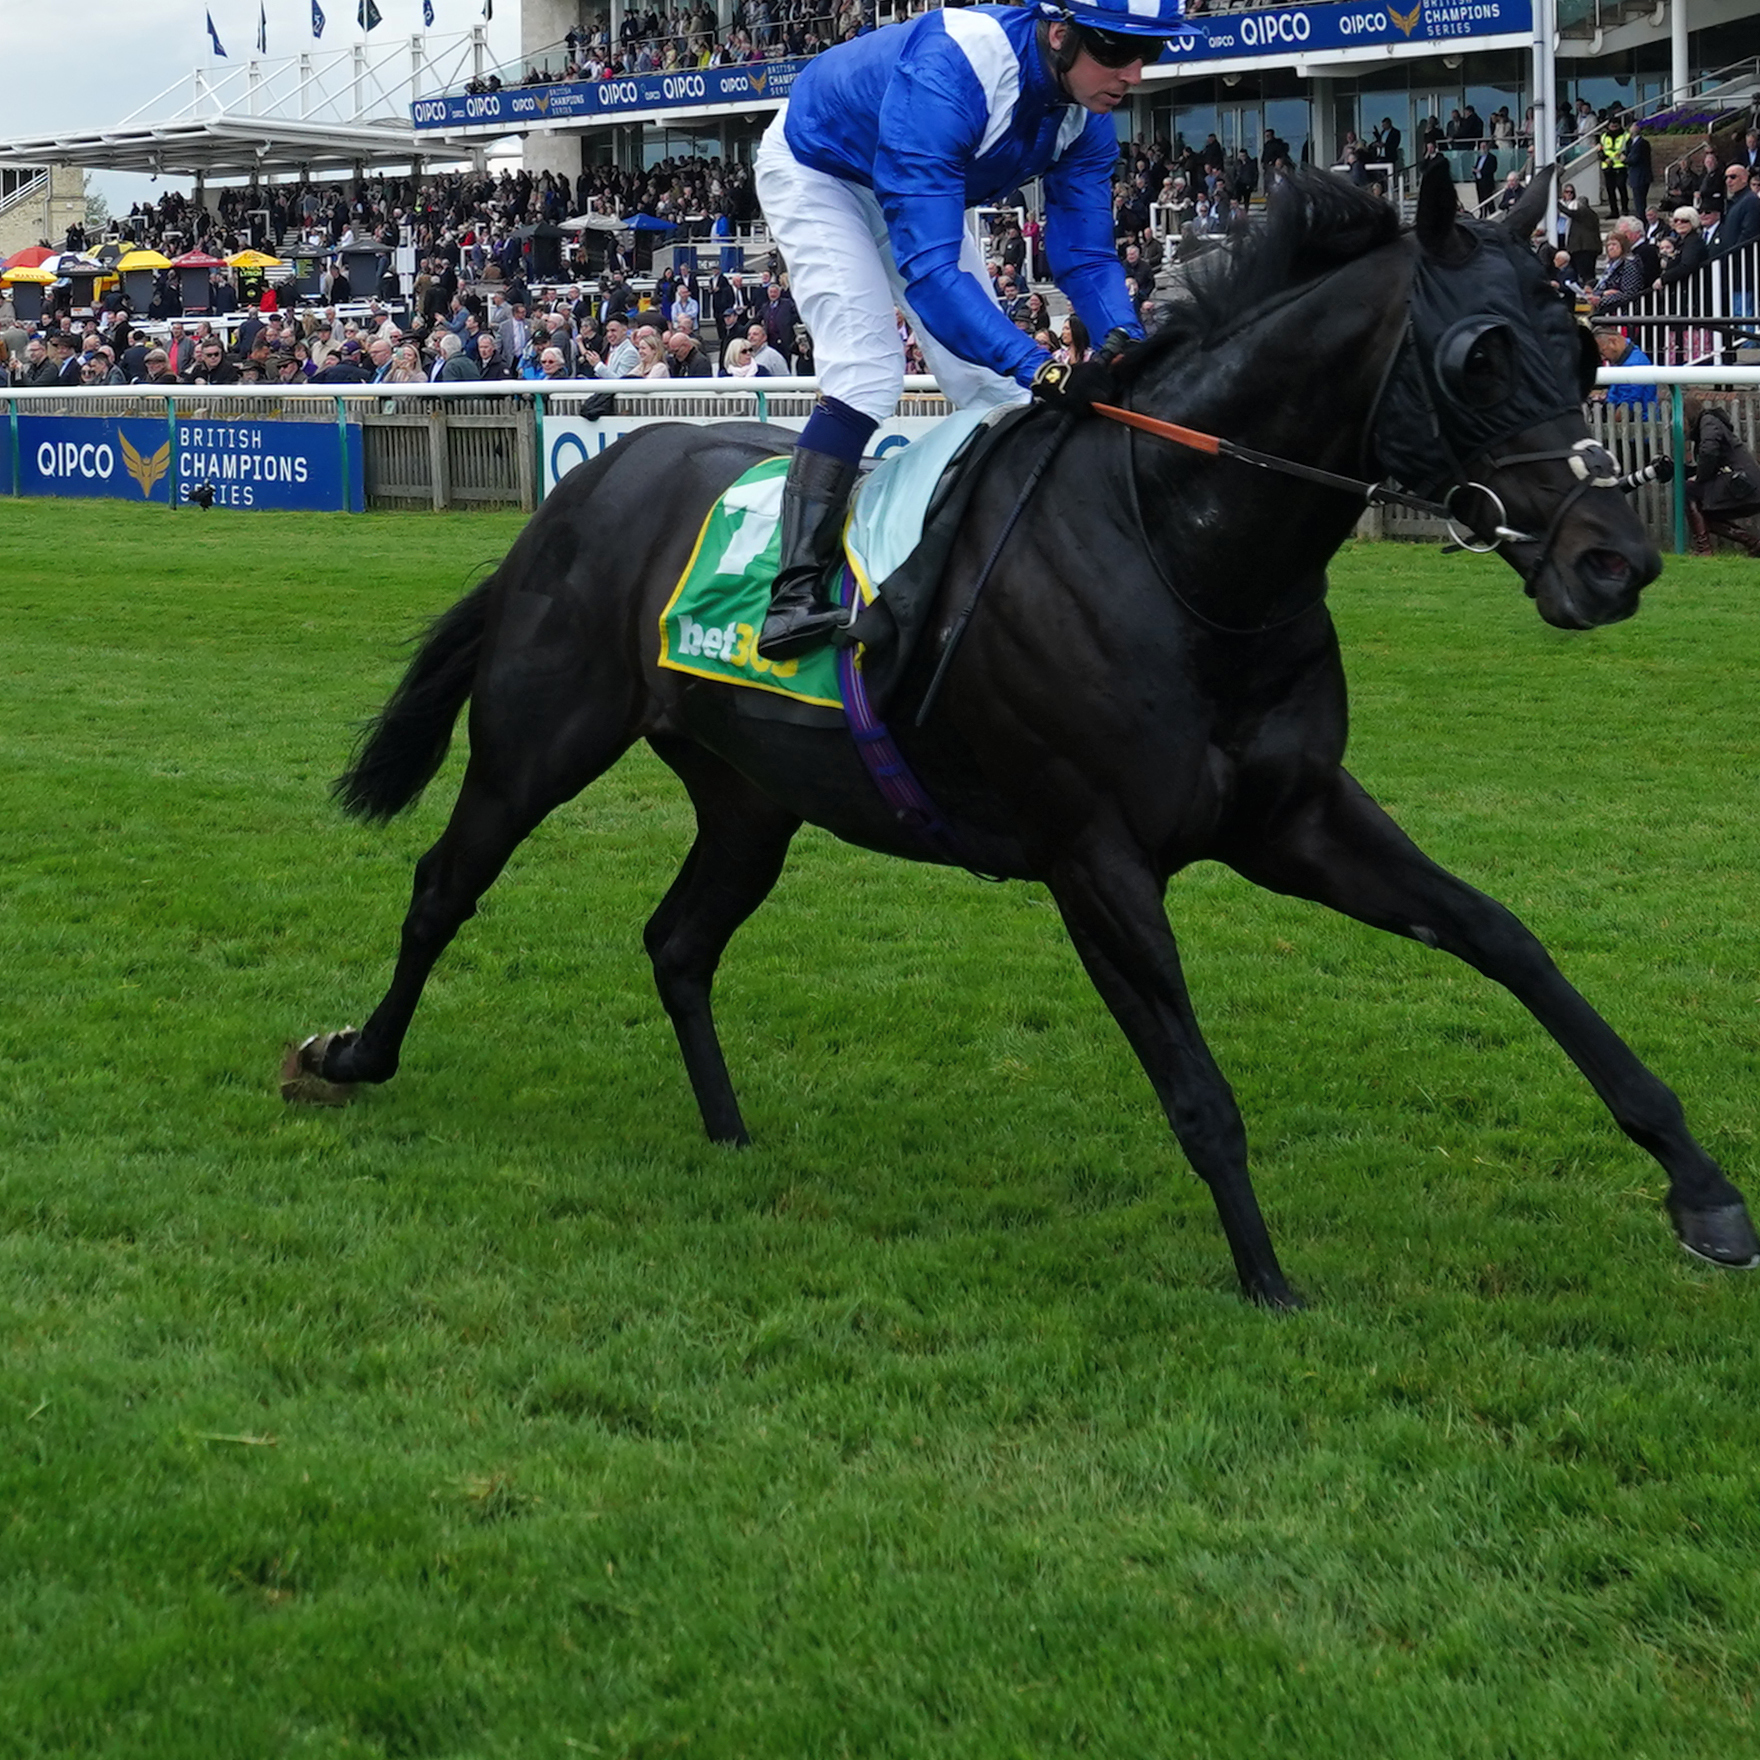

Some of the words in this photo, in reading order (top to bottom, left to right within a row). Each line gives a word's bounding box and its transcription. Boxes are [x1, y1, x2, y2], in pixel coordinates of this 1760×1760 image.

[1339, 12, 1387, 36] QIPCO
[1424, 4, 1500, 23] CHAMPIONS
[1240, 12, 1310, 46] QIPCO
[1426, 21, 1472, 36] SERIES
[1208, 34, 1234, 48] QIPCO
[663, 75, 705, 99] QIPCO
[720, 77, 749, 94] QIPCO
[768, 72, 800, 86] CHAMP
[770, 83, 791, 96] SERI
[550, 94, 585, 106] CHAMPIONS
[598, 82, 638, 106] QIPCO
[414, 102, 446, 122] QIPCO
[466, 95, 500, 118] QIPCO
[512, 98, 535, 112] QIPCO
[180, 427, 261, 449] BRITISH
[37, 441, 114, 479] QIPCO
[180, 452, 308, 482] CHAMPIONS
[180, 483, 254, 506] SIES
